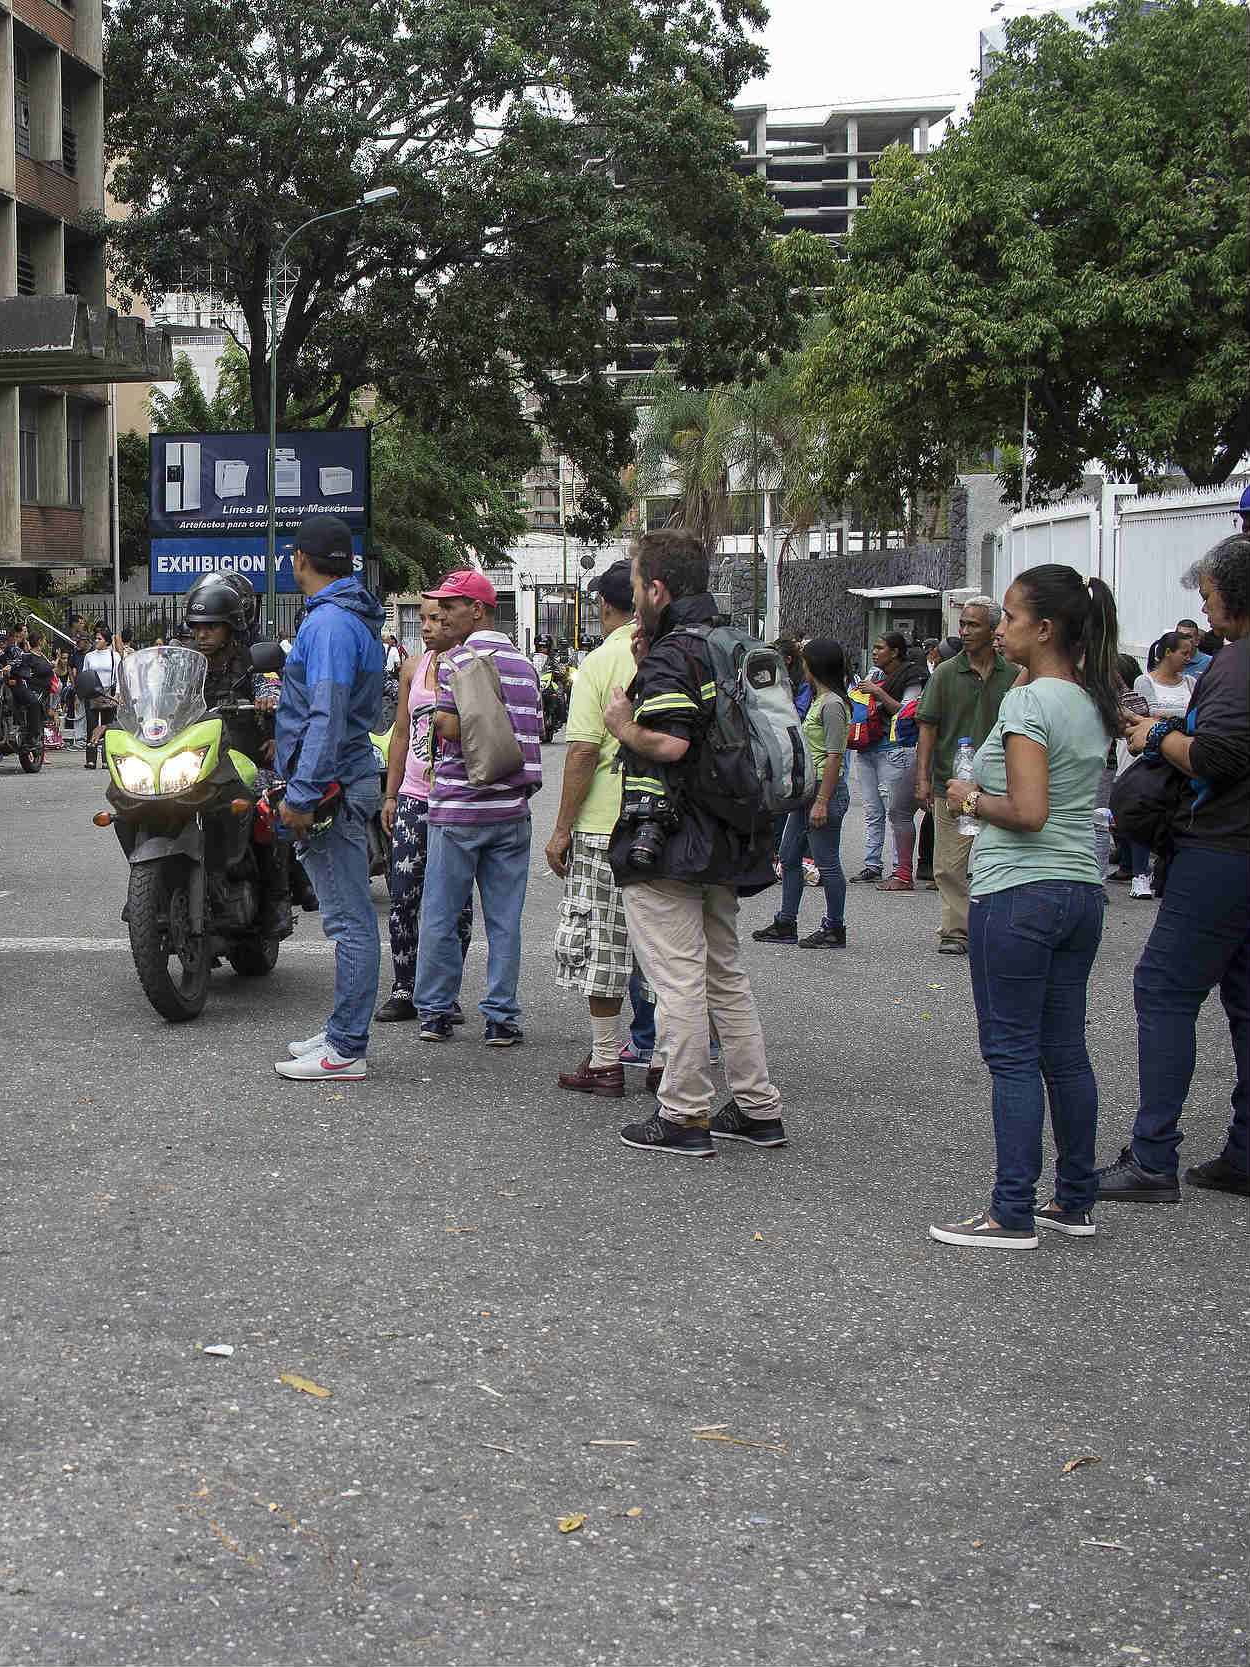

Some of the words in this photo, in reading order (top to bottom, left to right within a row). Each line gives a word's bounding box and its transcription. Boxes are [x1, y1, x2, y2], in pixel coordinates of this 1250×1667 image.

[256, 504, 295, 514] Blnca
[179, 520, 225, 528] Artefactos
[227, 521, 247, 530] para
[249, 520, 284, 528] cocias
[157, 554, 266, 572] EXHIBICION
[273, 554, 285, 571] Y
